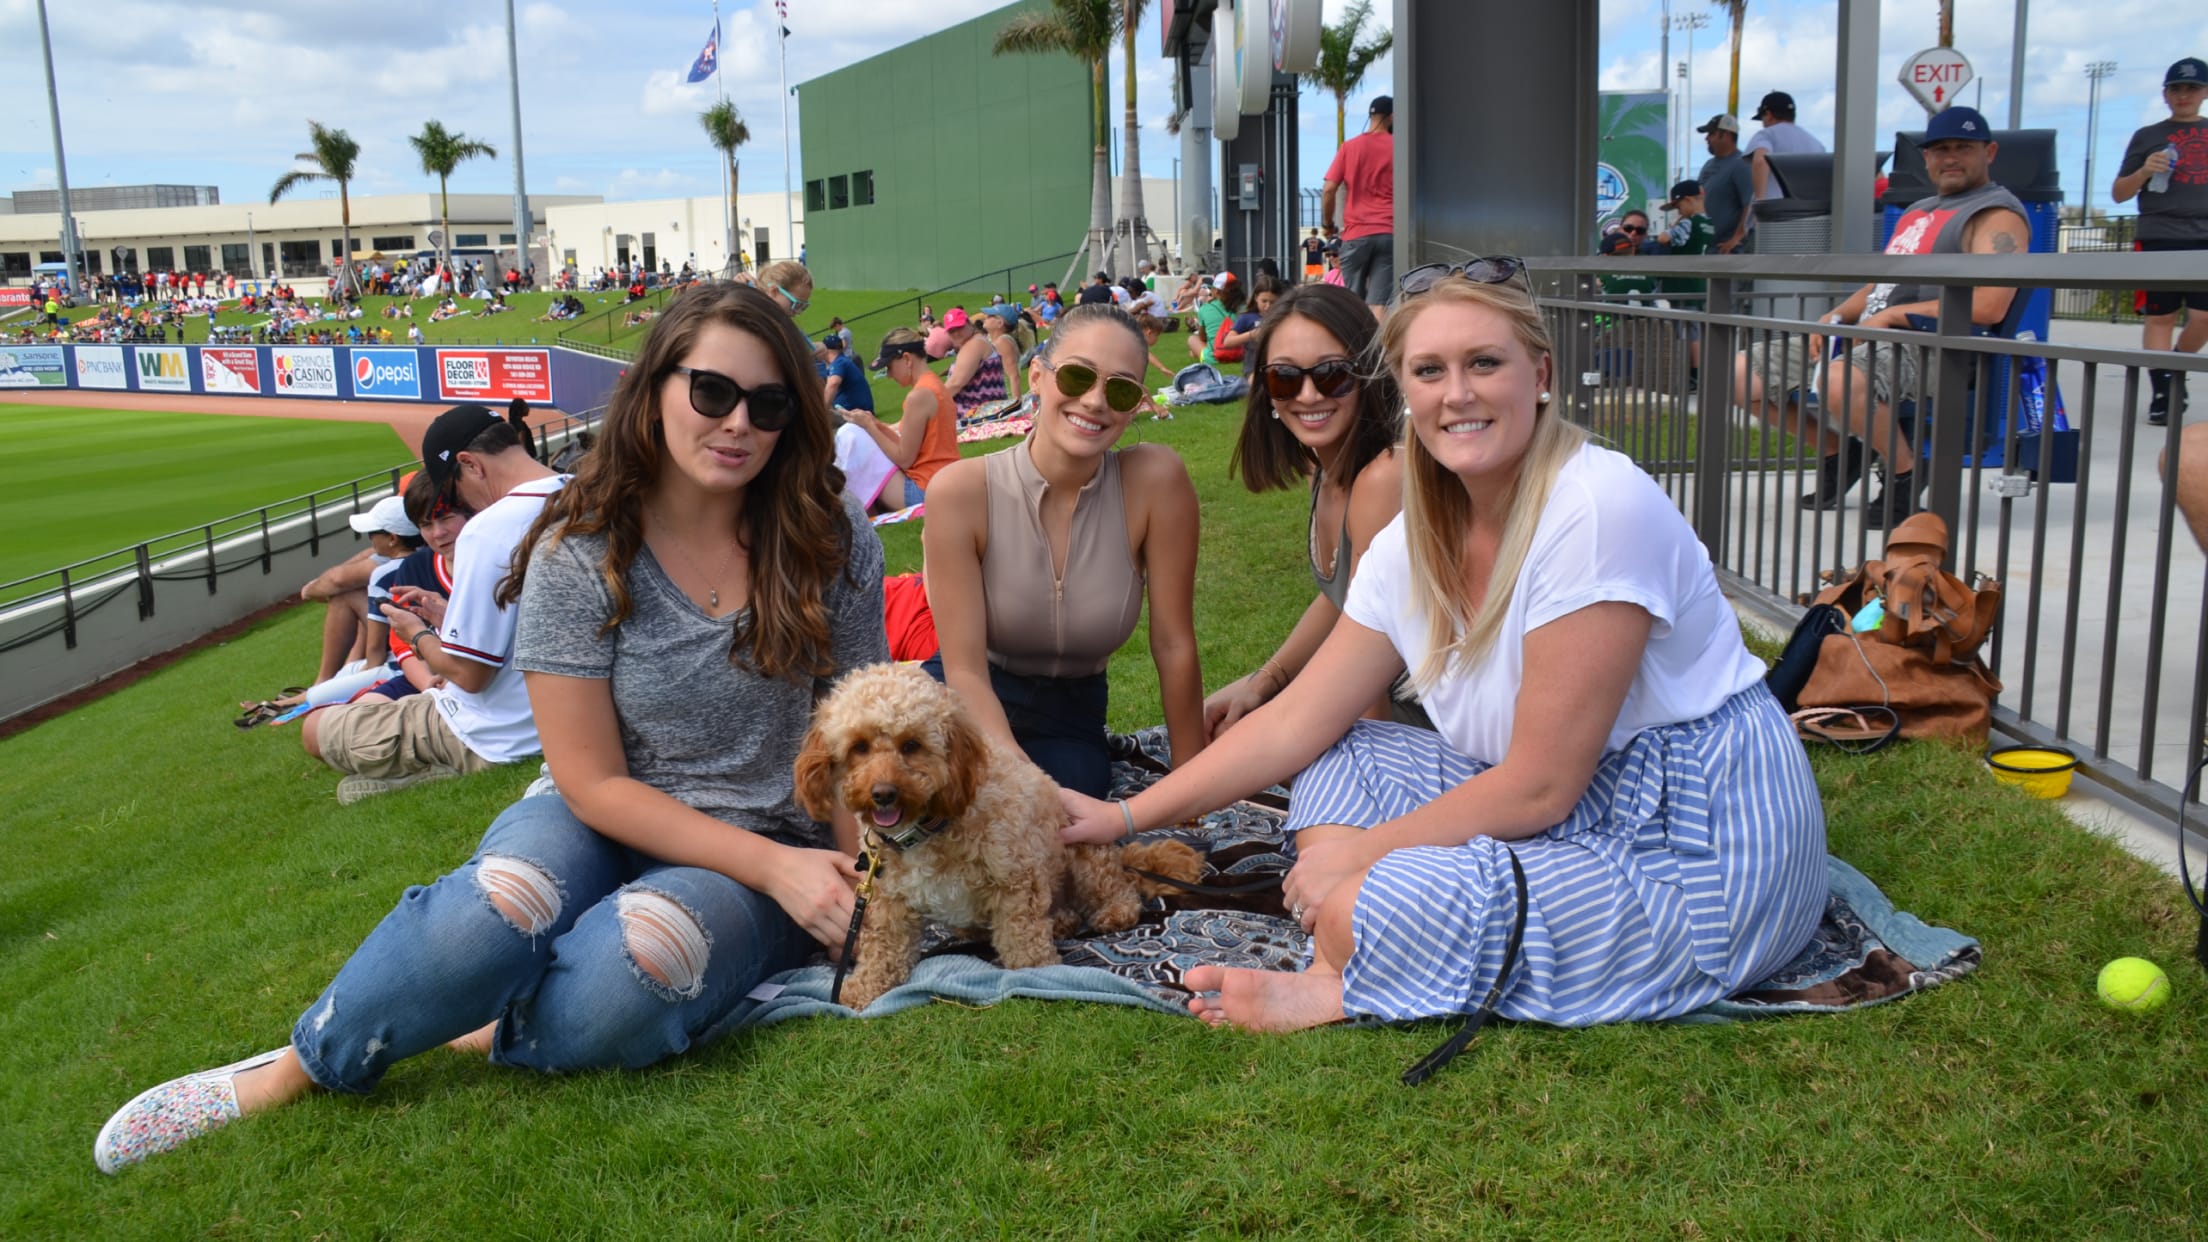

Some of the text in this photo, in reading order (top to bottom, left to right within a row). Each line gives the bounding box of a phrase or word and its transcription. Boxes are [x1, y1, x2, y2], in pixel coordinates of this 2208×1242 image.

[1914, 64, 1964, 83] EXIT
[139, 352, 185, 377] WM
[293, 355, 331, 367] SEMINOLE
[446, 360, 474, 370] FLOOR
[295, 368, 333, 382] CASINO
[376, 362, 414, 386] pepsi
[447, 370, 475, 380] DECOR
